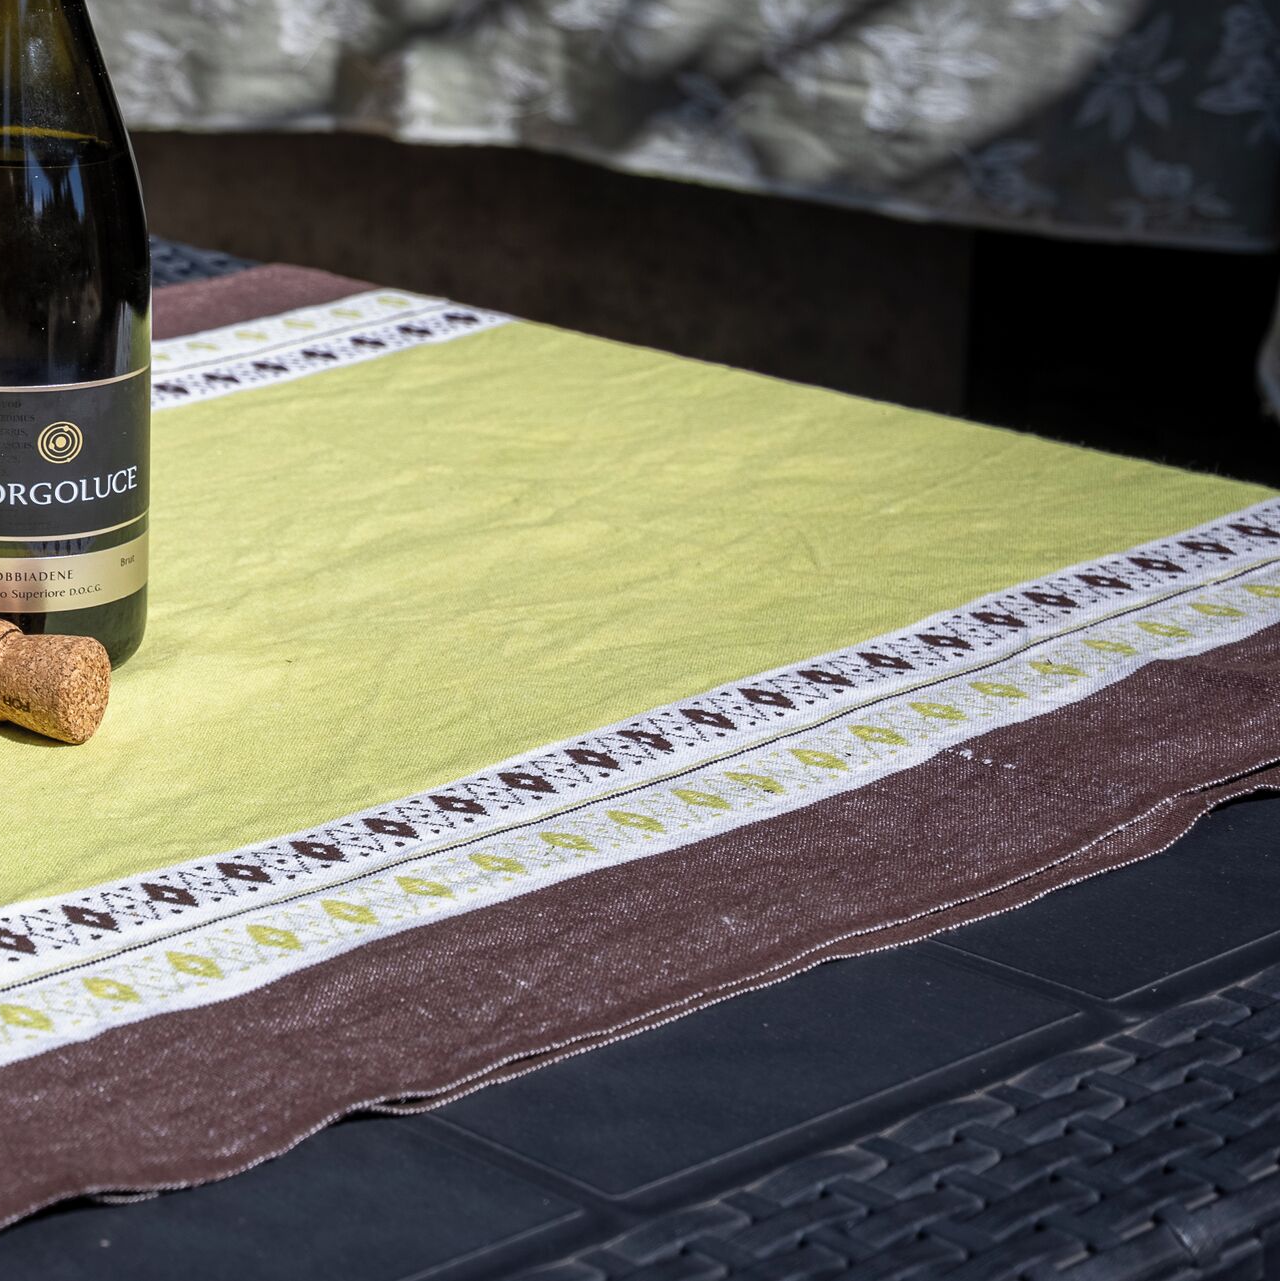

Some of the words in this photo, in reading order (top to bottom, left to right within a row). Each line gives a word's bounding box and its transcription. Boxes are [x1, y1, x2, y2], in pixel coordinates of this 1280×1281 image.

[120, 555, 136, 567] Brut
[11, 590, 66, 601] Superiore
[69, 584, 103, 596] D.O.C.G.
